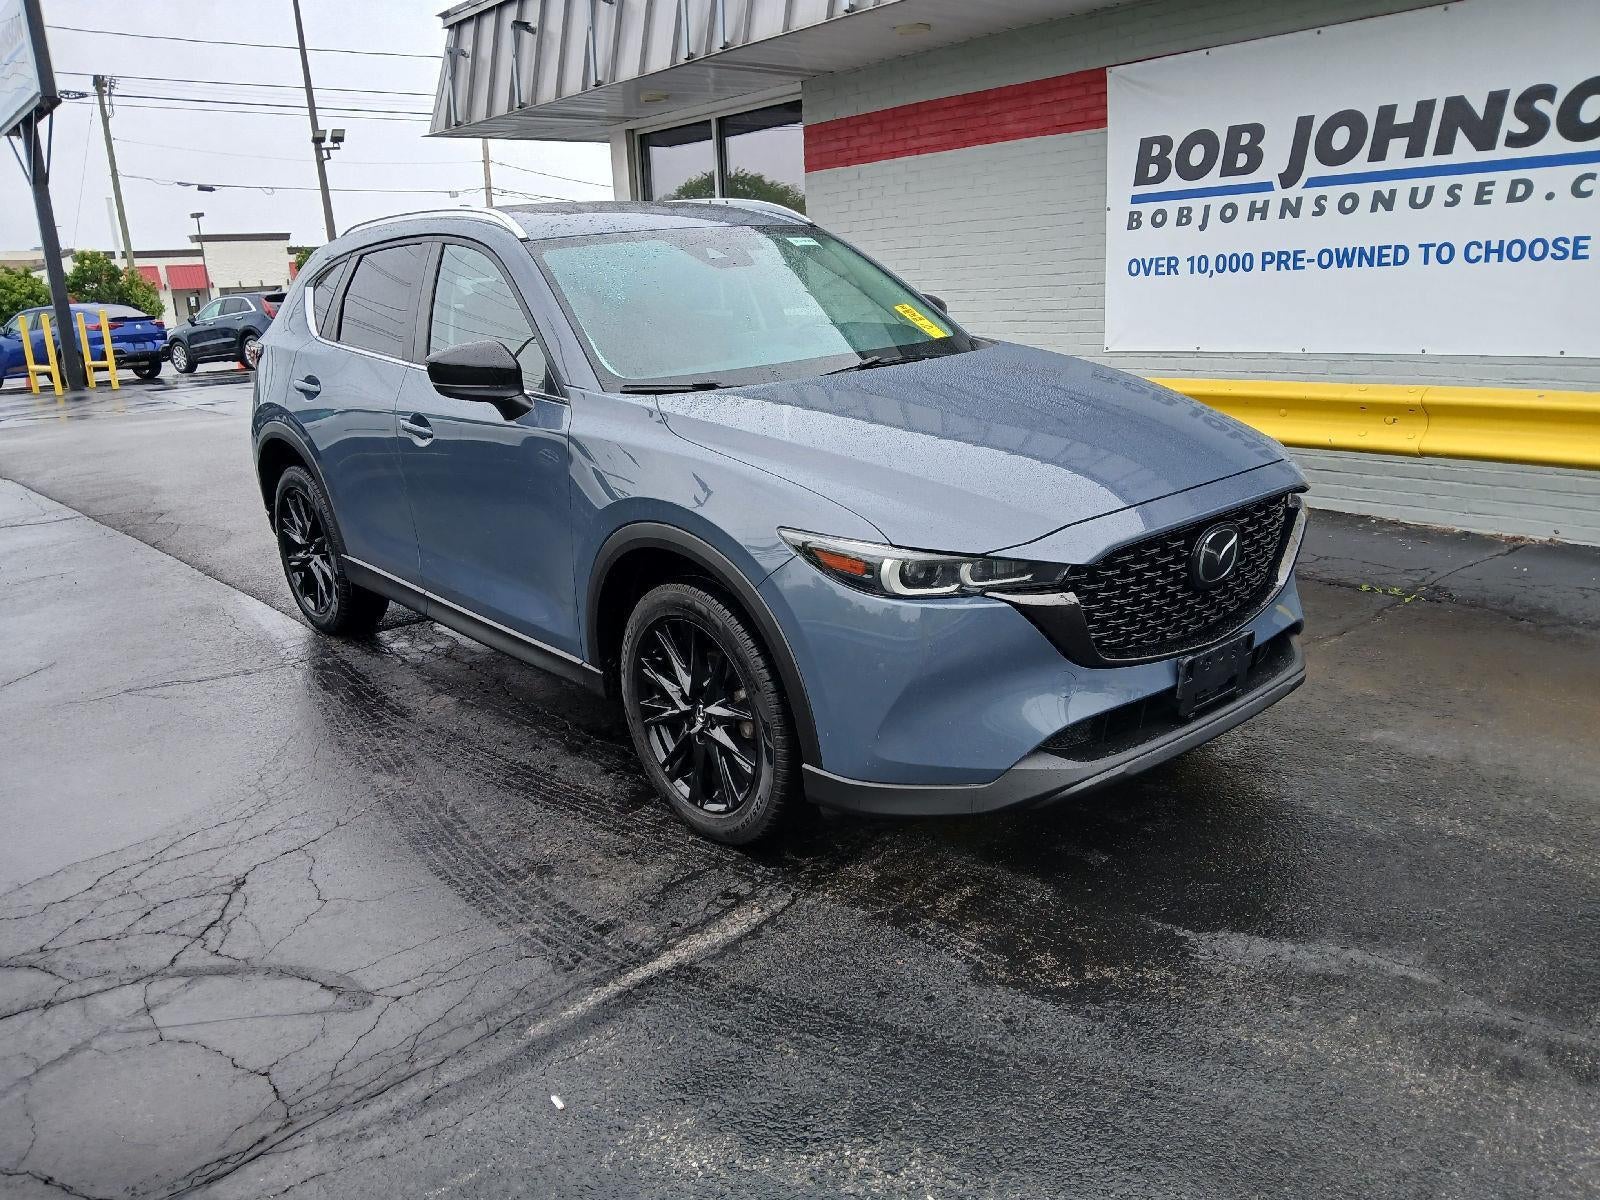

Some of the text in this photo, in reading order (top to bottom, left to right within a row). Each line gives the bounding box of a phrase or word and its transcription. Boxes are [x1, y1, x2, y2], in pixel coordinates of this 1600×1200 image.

[1133, 122, 1266, 187] BOB
[1126, 172, 1598, 232] BOBJOHNSONUSED.C
[1127, 235, 1592, 279] OVER 10,000 PRE-OWNED TO CHOOSE
